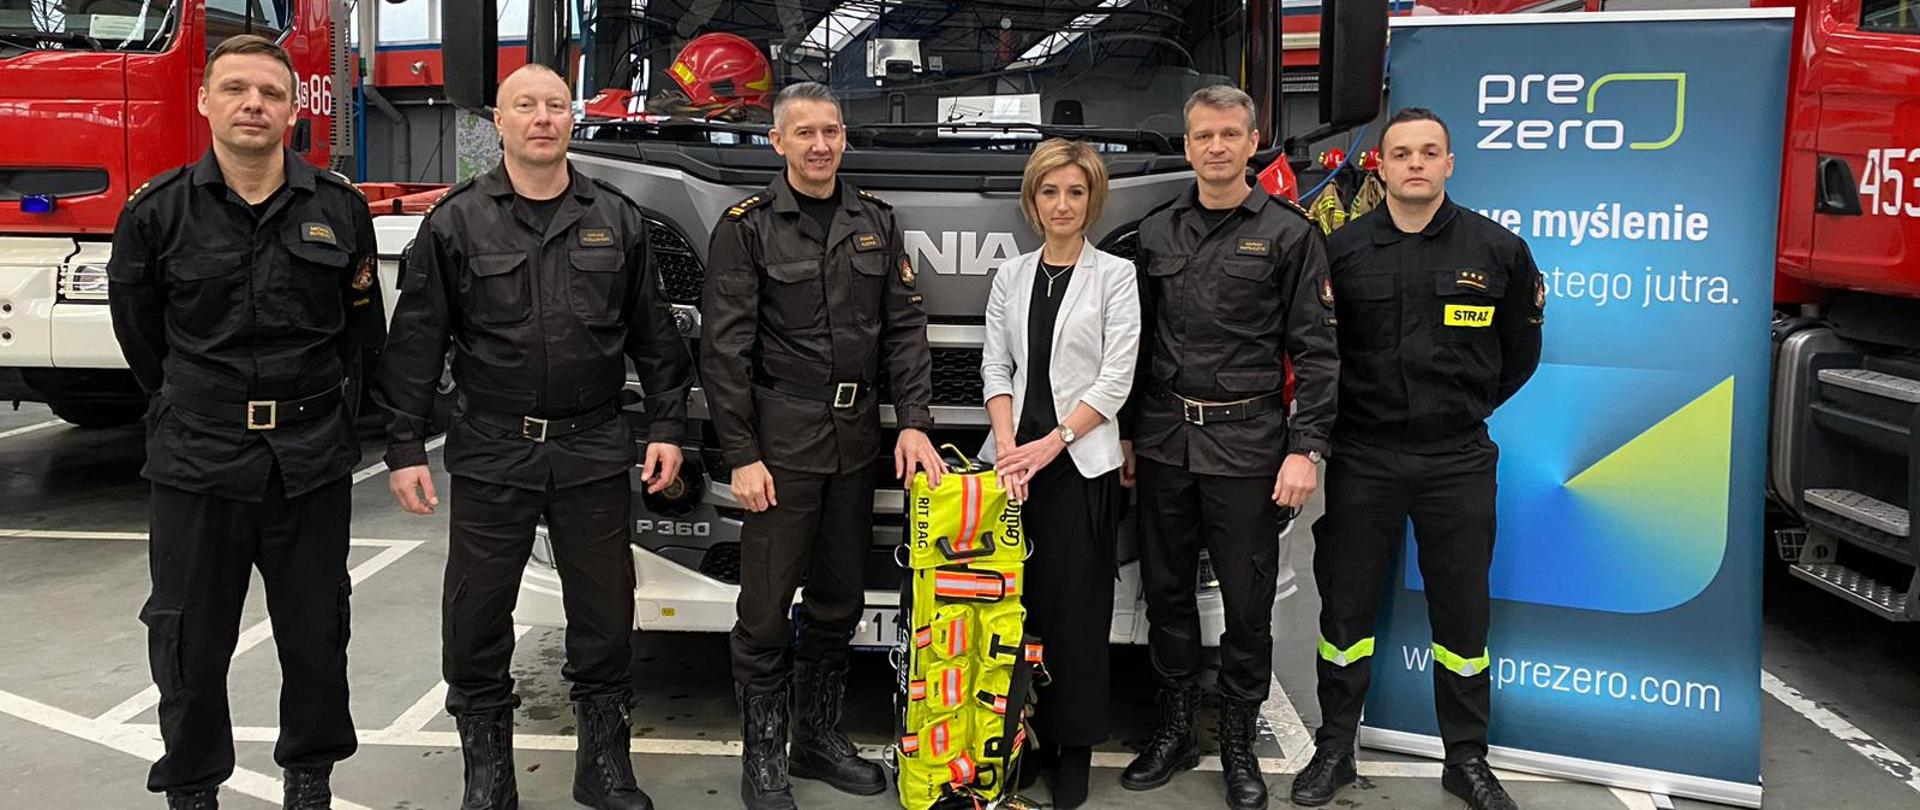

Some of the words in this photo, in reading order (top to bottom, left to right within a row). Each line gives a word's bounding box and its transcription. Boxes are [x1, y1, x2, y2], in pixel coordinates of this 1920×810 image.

[1478, 74, 1584, 113] pre
[1477, 119, 1624, 149] zero
[1532, 203, 1709, 246] myślenie
[904, 230, 1021, 275] NIA
[1540, 266, 1632, 307] stego
[1643, 266, 1739, 309] jutra.
[917, 497, 929, 517] RIT
[637, 520, 653, 534] P
[658, 521, 710, 536] 360
[917, 521, 929, 549] BAG
[1403, 645, 1721, 712] w.prezero.com
